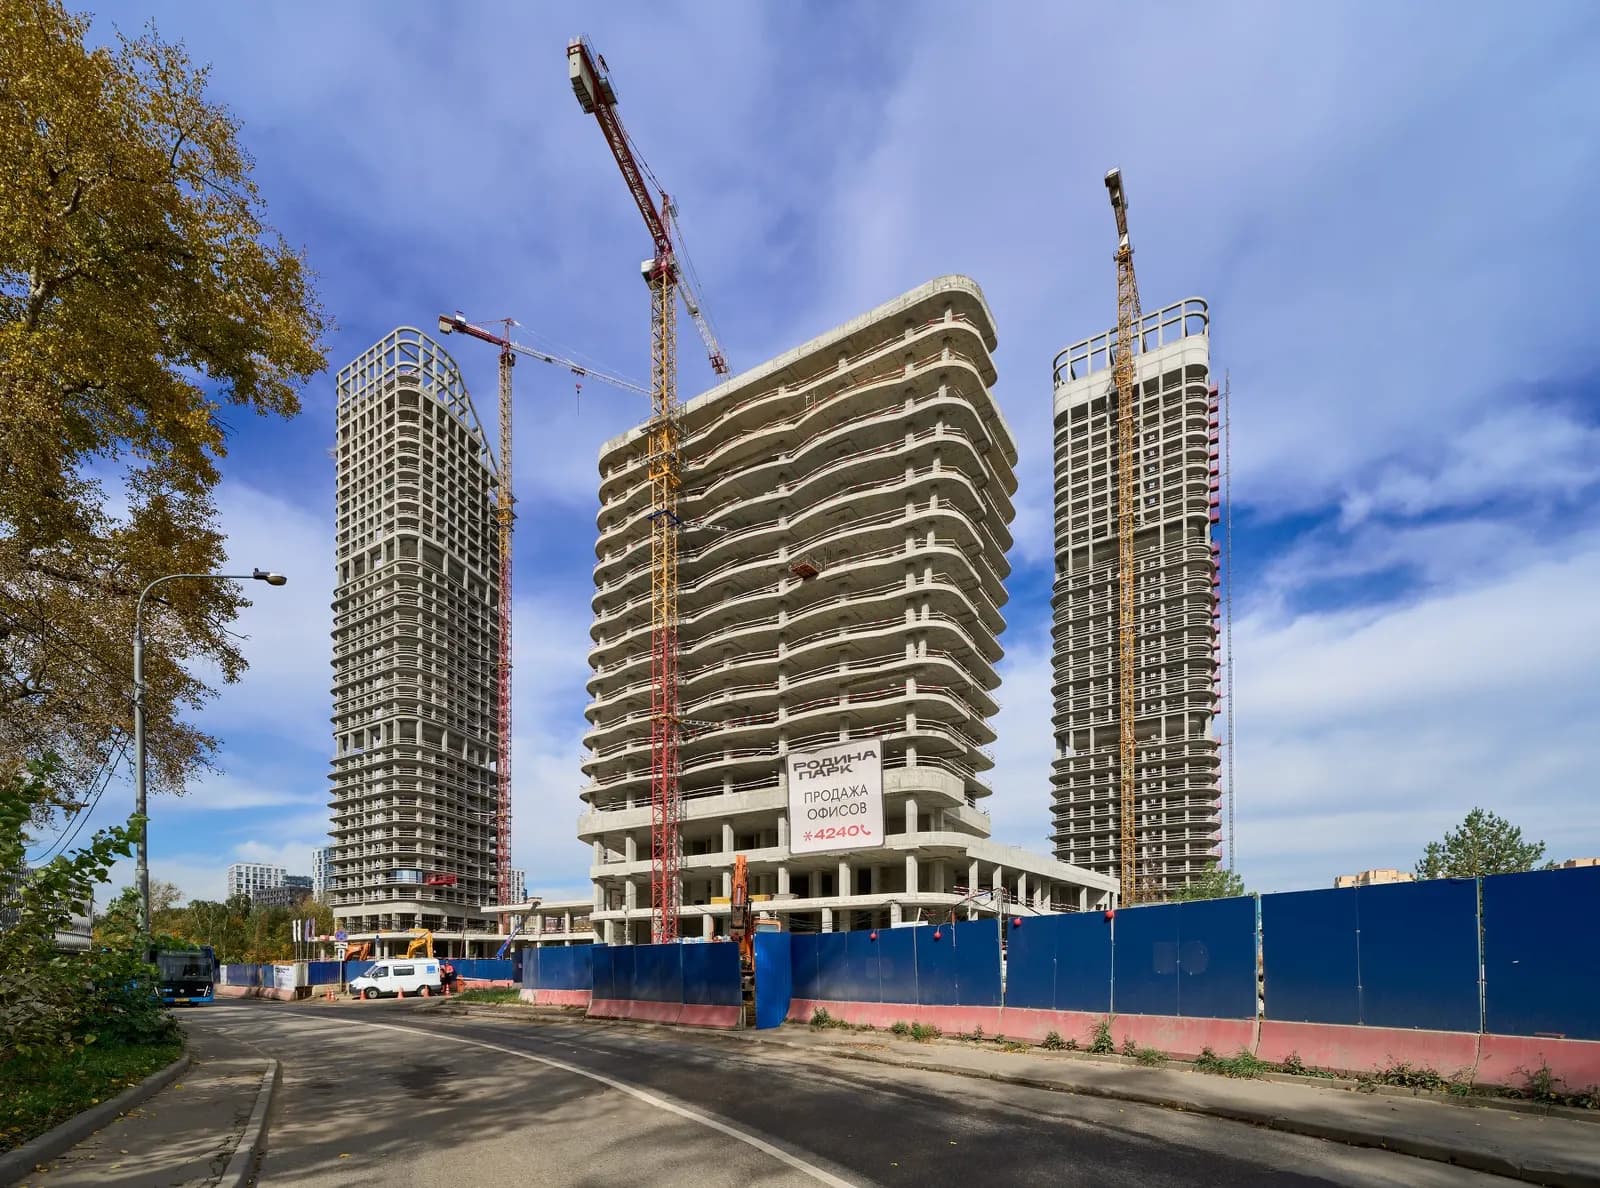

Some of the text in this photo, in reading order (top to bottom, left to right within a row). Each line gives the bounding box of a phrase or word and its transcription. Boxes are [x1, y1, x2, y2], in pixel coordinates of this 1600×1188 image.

[793, 750, 877, 771] РОДИНА
[799, 764, 853, 780] ПАРК
[804, 784, 868, 804] ПРОДАЖА
[807, 802, 867, 820] ОФИСОВ
